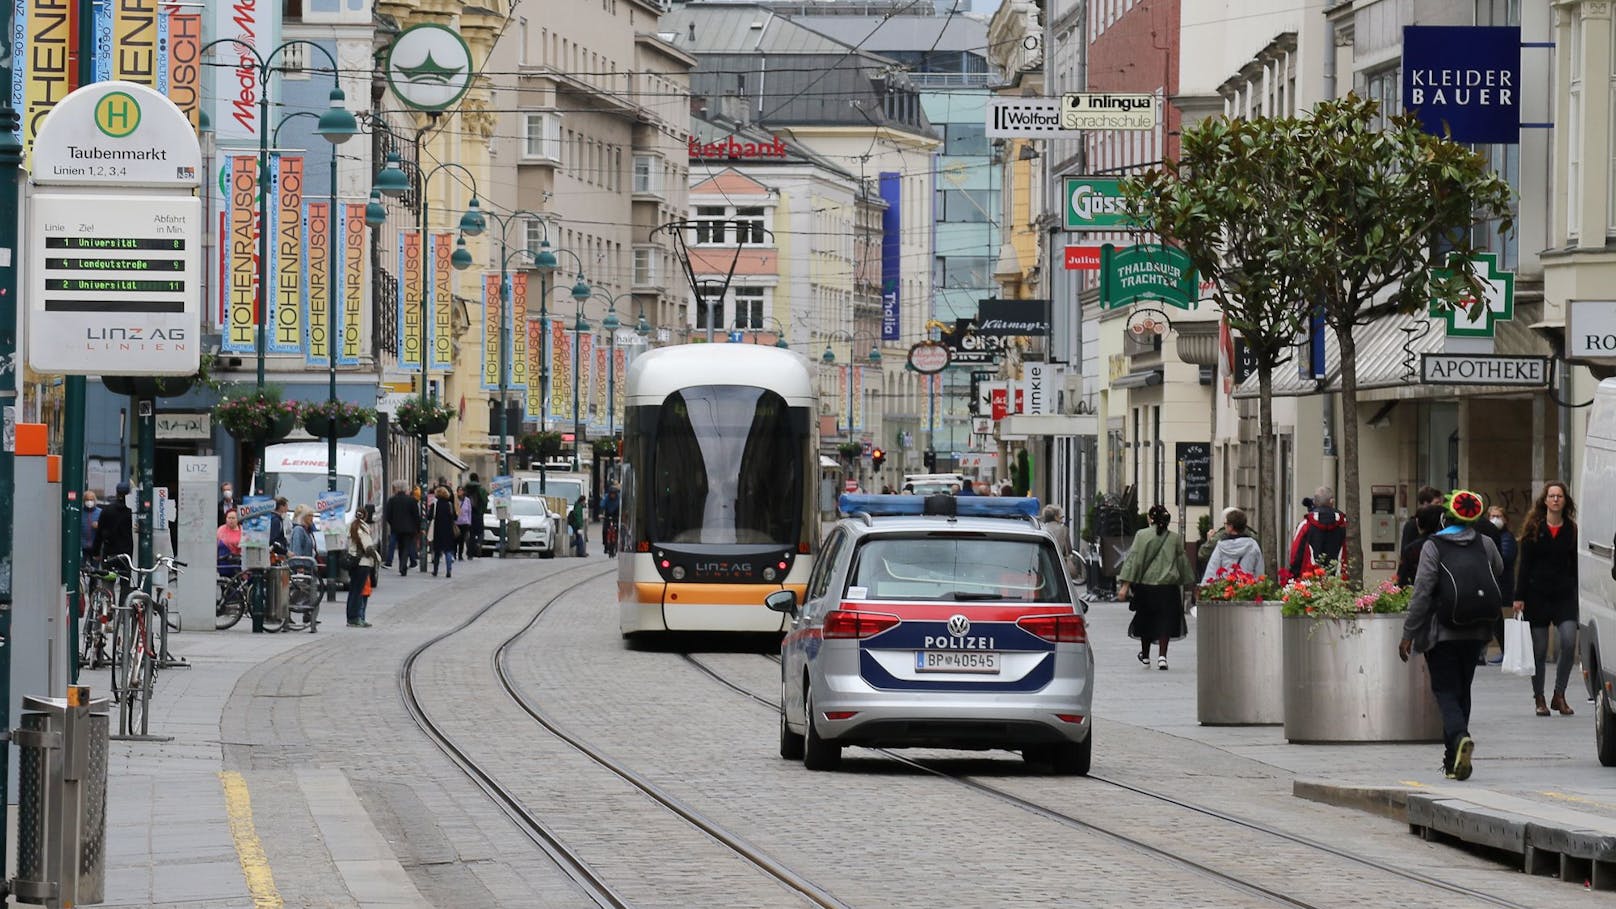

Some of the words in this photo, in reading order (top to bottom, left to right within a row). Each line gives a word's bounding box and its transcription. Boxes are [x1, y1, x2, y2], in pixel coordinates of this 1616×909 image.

[15, 24, 24, 57] 06.05.
[1412, 69, 1512, 87] KLEIDER
[232, 54, 256, 134] Media
[1412, 88, 1513, 105] BAUER
[1089, 95, 1151, 111] inlingua
[108, 101, 128, 128] H
[1007, 112, 1059, 125] Wolford
[1066, 114, 1151, 129] Sprachschule
[67, 146, 167, 161] Taubenmarkt
[688, 135, 787, 159] berbank
[53, 166, 85, 176] Linien
[154, 214, 186, 224] Abfahrt
[45, 223, 65, 232] Linie
[78, 223, 95, 232] Ziel
[166, 224, 186, 234] Min.
[233, 158, 254, 343] HÖHENRAUSCH
[279, 158, 301, 344] HÖHENRAUSCH
[1067, 256, 1100, 264] Julius
[1117, 261, 1182, 280] THALBAUER
[62, 280, 69, 289] 2
[169, 282, 179, 290] 11
[311, 204, 325, 356] HÖHENRAUSCH
[345, 204, 364, 356] HÖHENRAUSCH
[1120, 273, 1178, 288] TRACHTEN
[404, 235, 420, 363] HÖHENRAUSCH
[436, 235, 450, 363] HÖHENRAUSCH
[884, 291, 896, 334] Thalia
[87, 328, 143, 339] LINZ
[150, 328, 185, 340] AG
[87, 343, 185, 351] LINIEN
[1430, 360, 1540, 380] APOTHEKE
[281, 458, 329, 467] LENNE
[731, 563, 752, 571] AG
[924, 636, 994, 649] POLIZEI
[928, 654, 943, 666] BP
[954, 655, 994, 668] 40545
